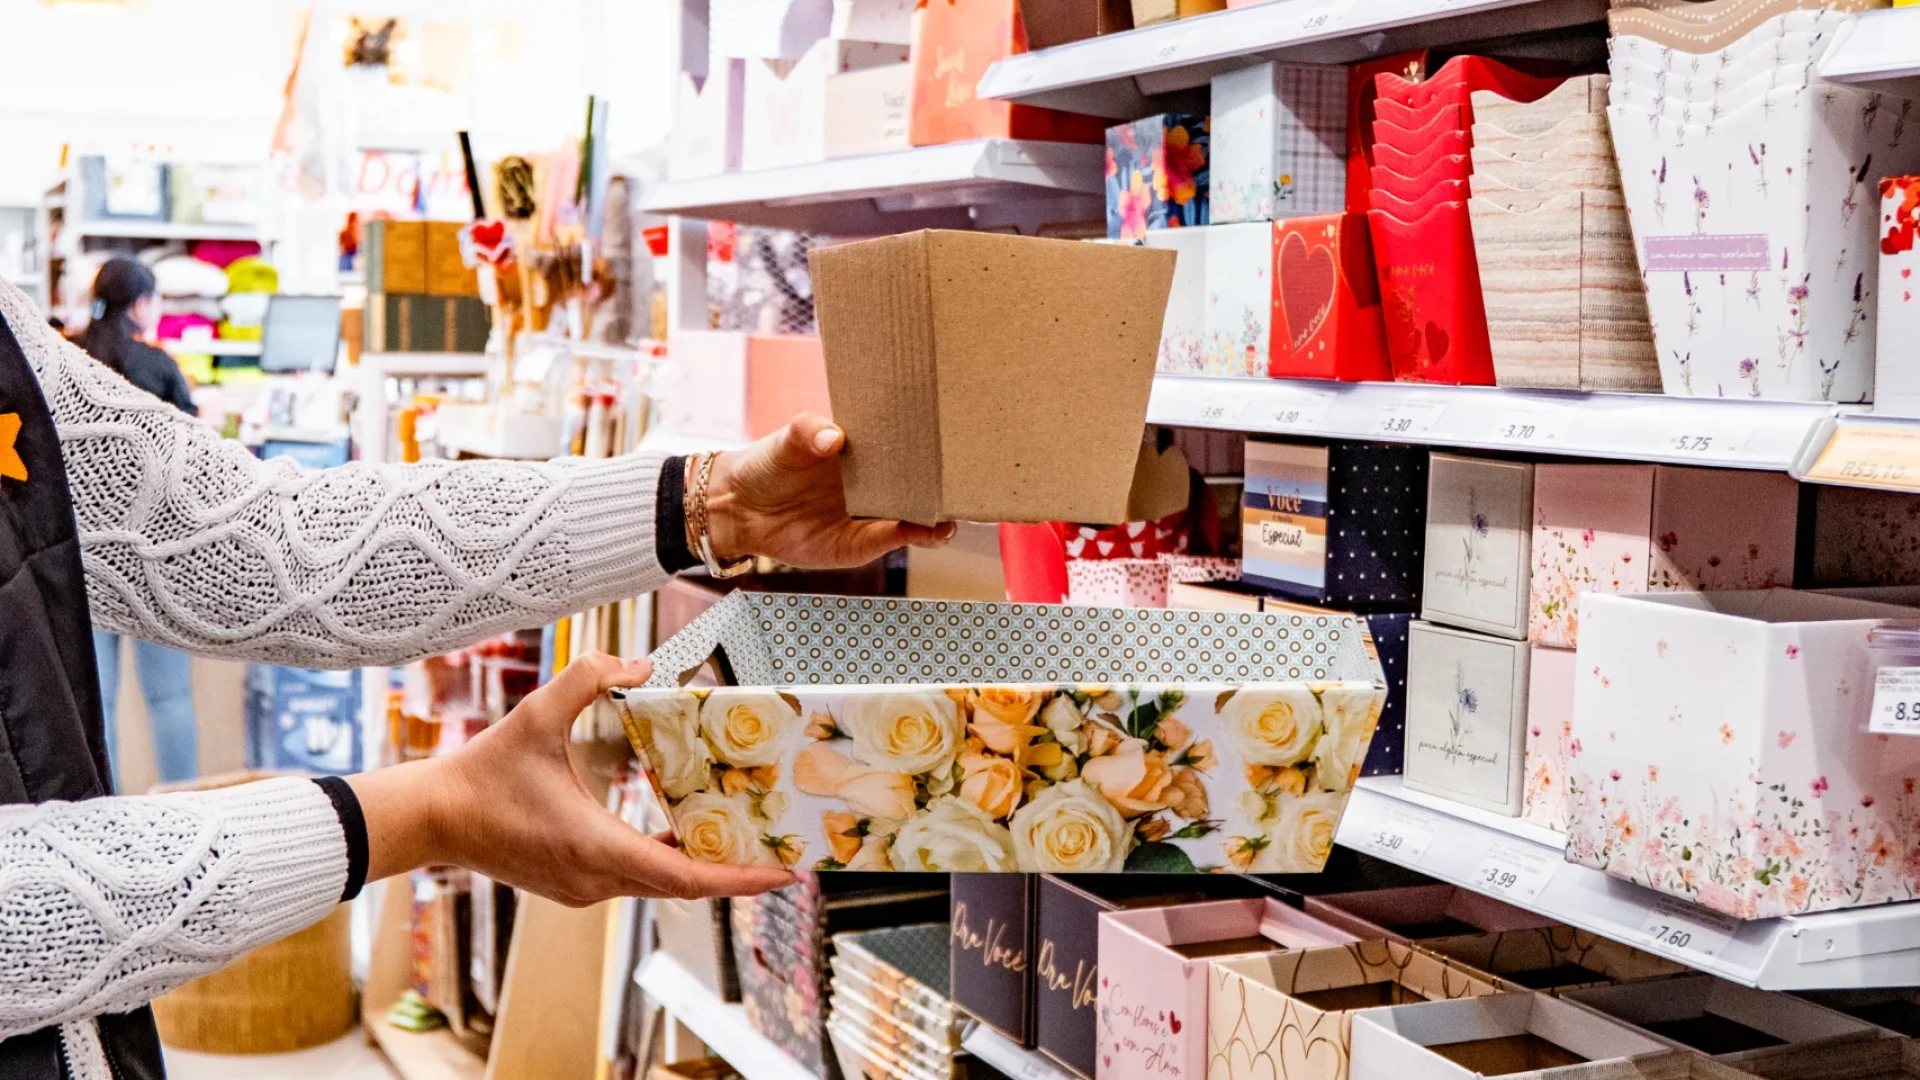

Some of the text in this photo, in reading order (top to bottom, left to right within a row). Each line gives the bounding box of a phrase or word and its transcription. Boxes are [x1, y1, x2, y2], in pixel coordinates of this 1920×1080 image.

[1276, 411, 1299, 423] 4.90
[1384, 418, 1411, 432] 3.30
[1504, 425, 1535, 438] 3.70
[1676, 436, 1712, 451] 5.75
[1267, 485, 1302, 513] Você
[1262, 524, 1302, 548] Especial
[1435, 570, 1452, 581] para
[1479, 577, 1507, 589] especial
[1418, 741, 1438, 752] para
[1467, 752, 1498, 765] especial
[1375, 831, 1403, 850] 5.30
[1486, 868, 1517, 888] 3.99
[1656, 926, 1691, 947] 7.60
[1142, 1042, 1182, 1077] Amor
